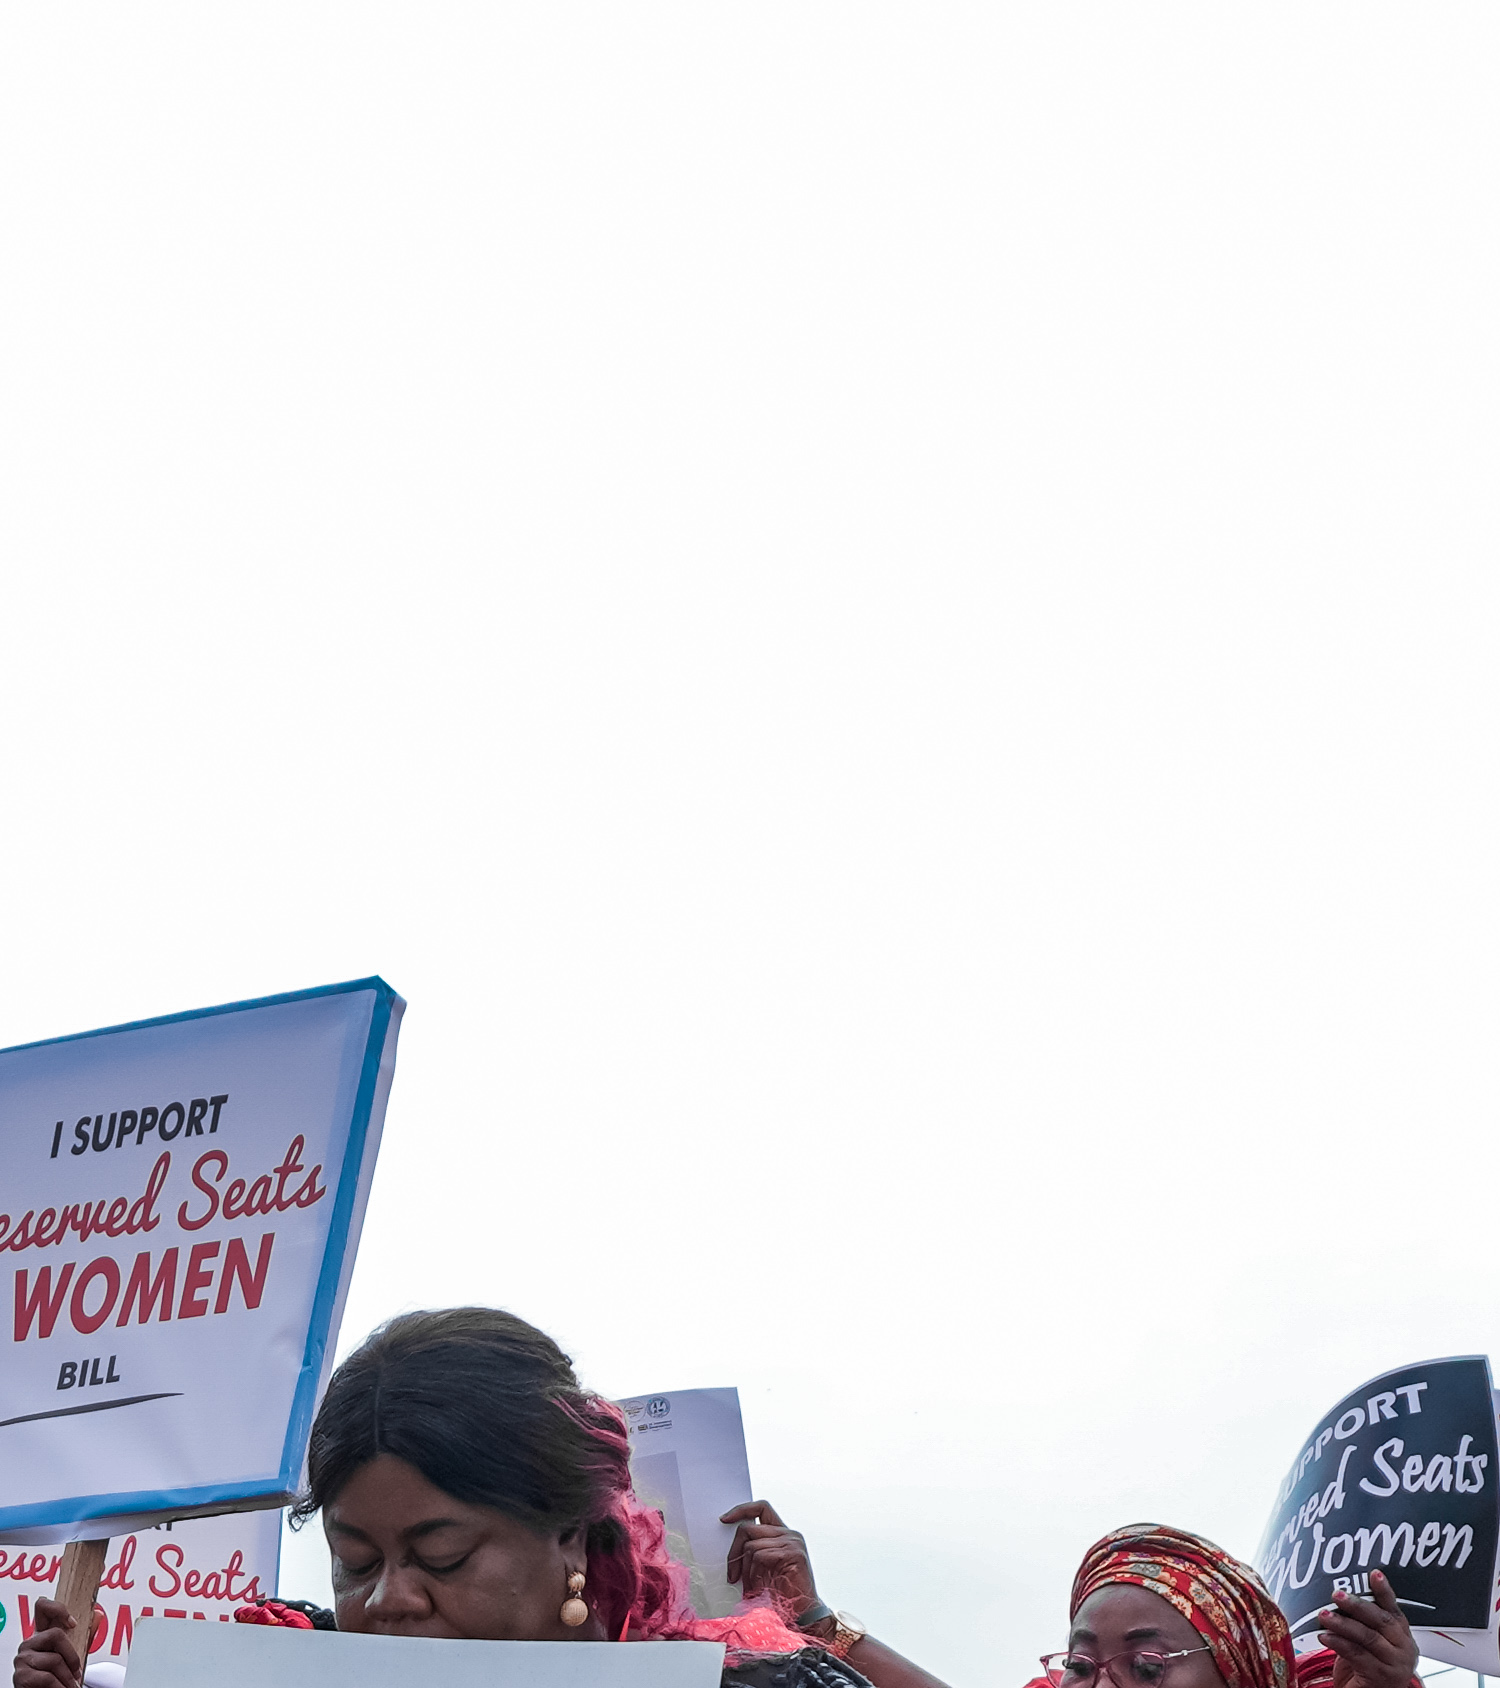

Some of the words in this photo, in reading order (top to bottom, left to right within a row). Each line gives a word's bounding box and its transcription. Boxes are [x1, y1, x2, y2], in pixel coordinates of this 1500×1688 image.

[50, 1121, 64, 1159] I
[71, 1094, 228, 1156] SUPPORT
[177, 1134, 327, 1230] Seats
[12, 1232, 276, 1343] WOMEN
[56, 1355, 120, 1391] BILL
[1284, 1382, 1428, 1501] UPPORT
[1359, 1434, 1487, 1498] Seats
[149, 1544, 266, 1601] Seats
[1267, 1521, 1473, 1600] Women
[1333, 1572, 1373, 1594] BIL
